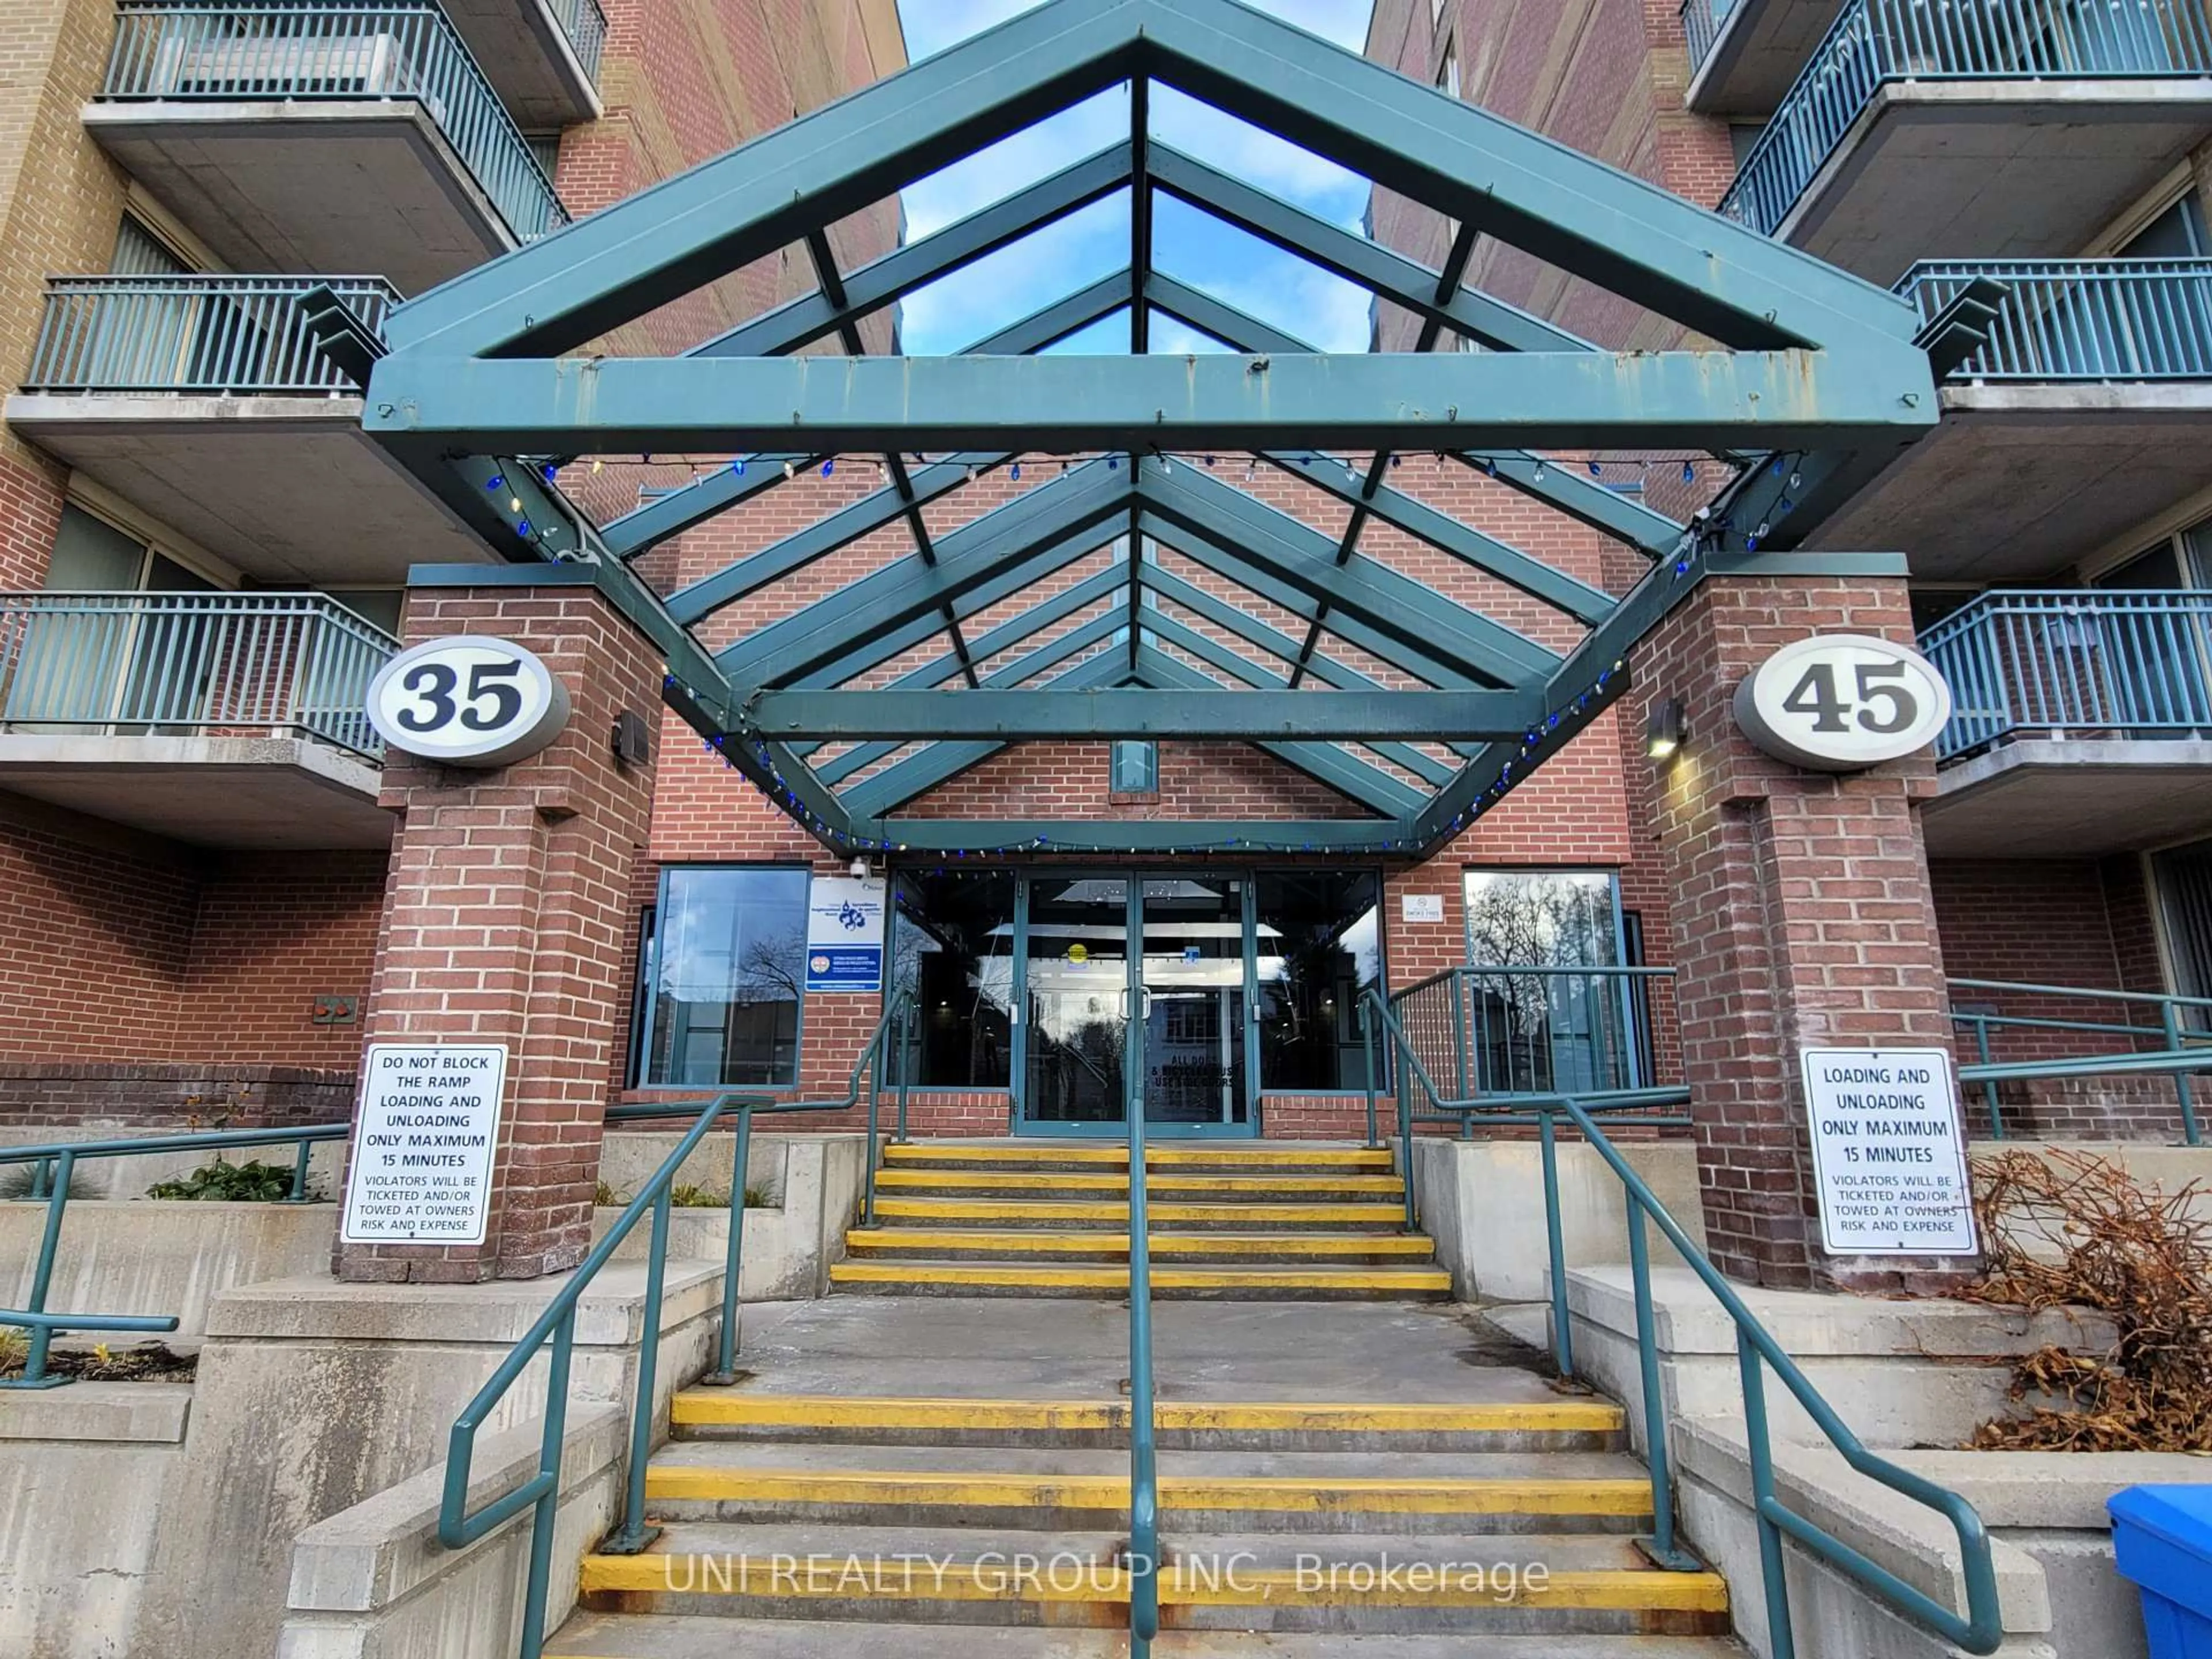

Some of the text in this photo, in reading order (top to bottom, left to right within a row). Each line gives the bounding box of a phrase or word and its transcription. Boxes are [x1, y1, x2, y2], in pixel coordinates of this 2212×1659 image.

[397, 659, 521, 732] 35
[1782, 660, 1917, 733] 45
[383, 1058, 488, 1069] DO NOT BLOCK
[1824, 1069, 1929, 1083] LOADING AND
[397, 1077, 471, 1088] THE RAMP
[381, 1096, 481, 1107] LOADING AND
[1836, 1094, 1925, 1109] UNLOADING
[387, 1115, 469, 1127] UNLOADING
[1823, 1120, 1947, 1135] ONLY MAXIMUM
[368, 1135, 484, 1146] ONLY MAXIMUM
[382, 1154, 465, 1166] 15 MINUTES
[1844, 1147, 1932, 1162] 15 MINUTES
[365, 1176, 477, 1186] VIOLATORS WILL BE
[1832, 1176, 1951, 1186] VIOLATORS WILL BE
[368, 1191, 469, 1200] TICKETED AND/OR
[1839, 1191, 1949, 1201] TICKETED AND/OR
[359, 1205, 474, 1215] TOWED AT OWNERS
[1834, 1206, 1958, 1217] TOWED AT OWNERS
[361, 1220, 468, 1230] RISK AND EXPENSE
[1841, 1221, 1954, 1232] RISK AND EXPENSE
